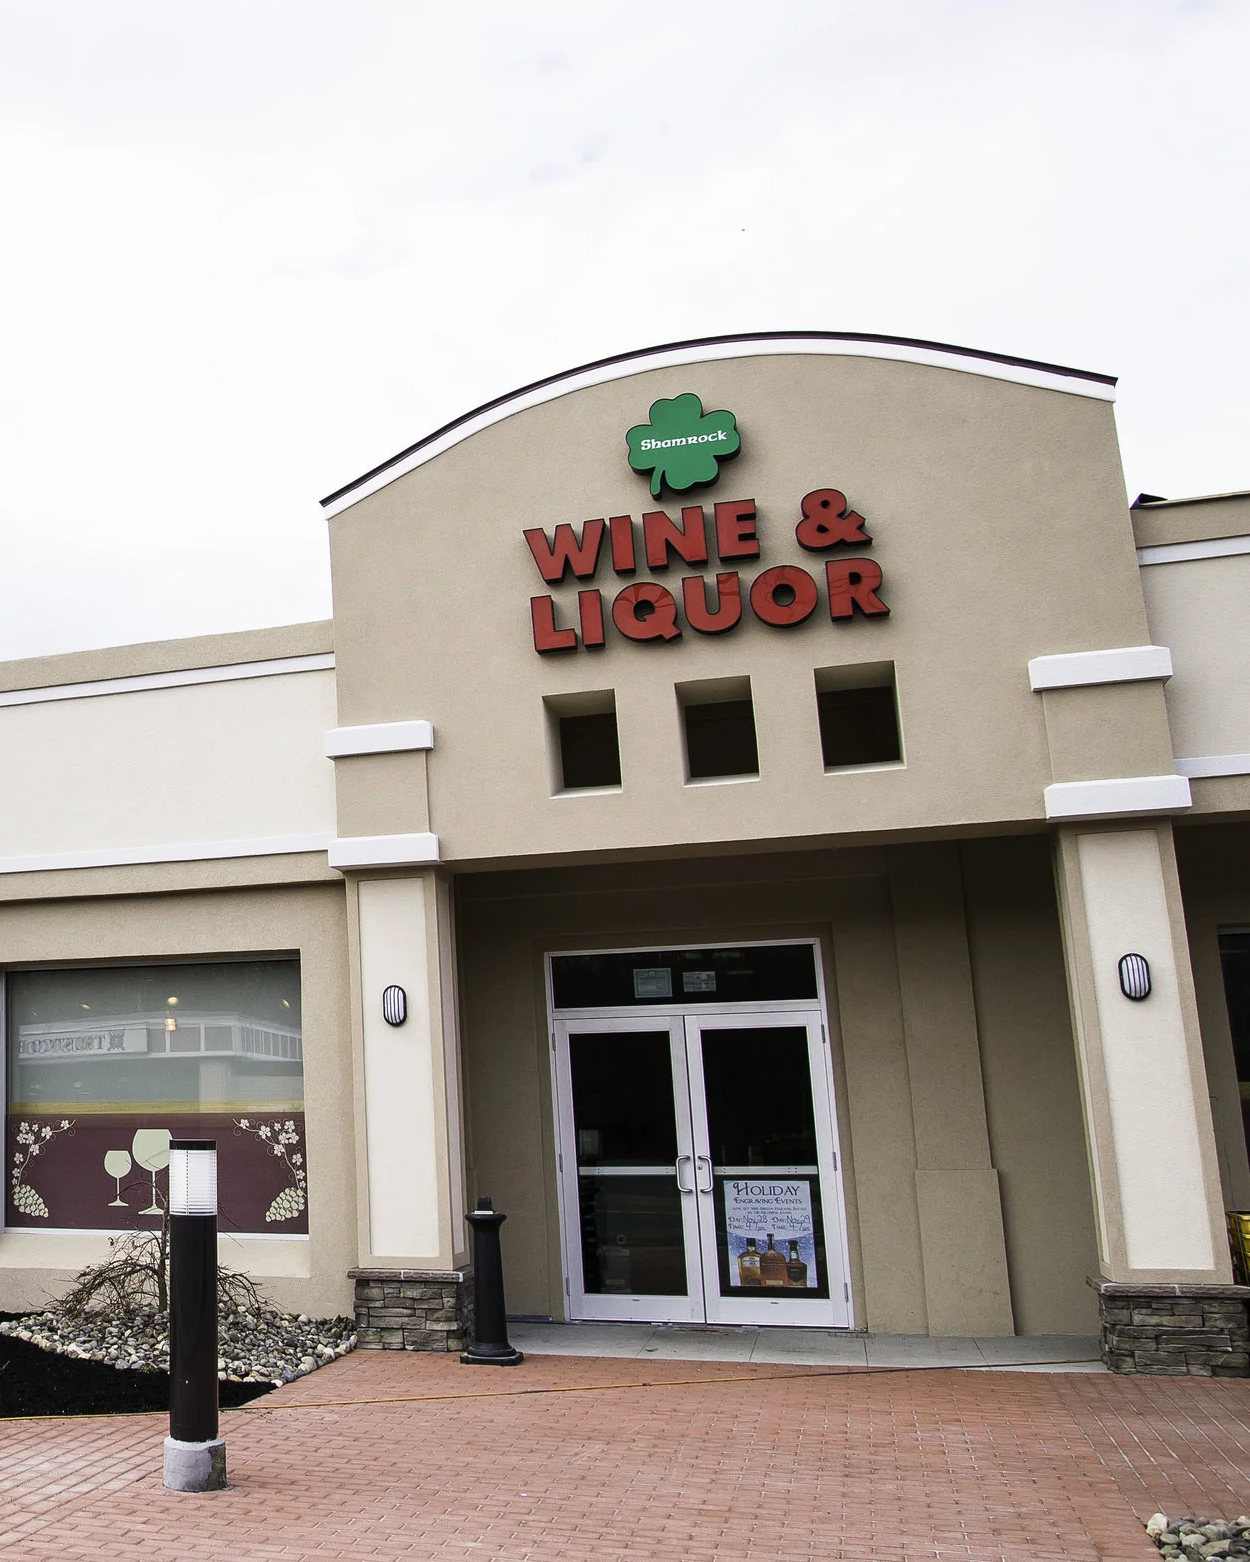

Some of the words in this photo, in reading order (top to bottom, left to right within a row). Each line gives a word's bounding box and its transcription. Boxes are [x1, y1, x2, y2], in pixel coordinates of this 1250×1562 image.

[522, 498, 761, 585] WINE
[795, 487, 873, 553] &
[530, 557, 891, 655] LIQUOR
[733, 1182, 800, 1196] HOLIDAY
